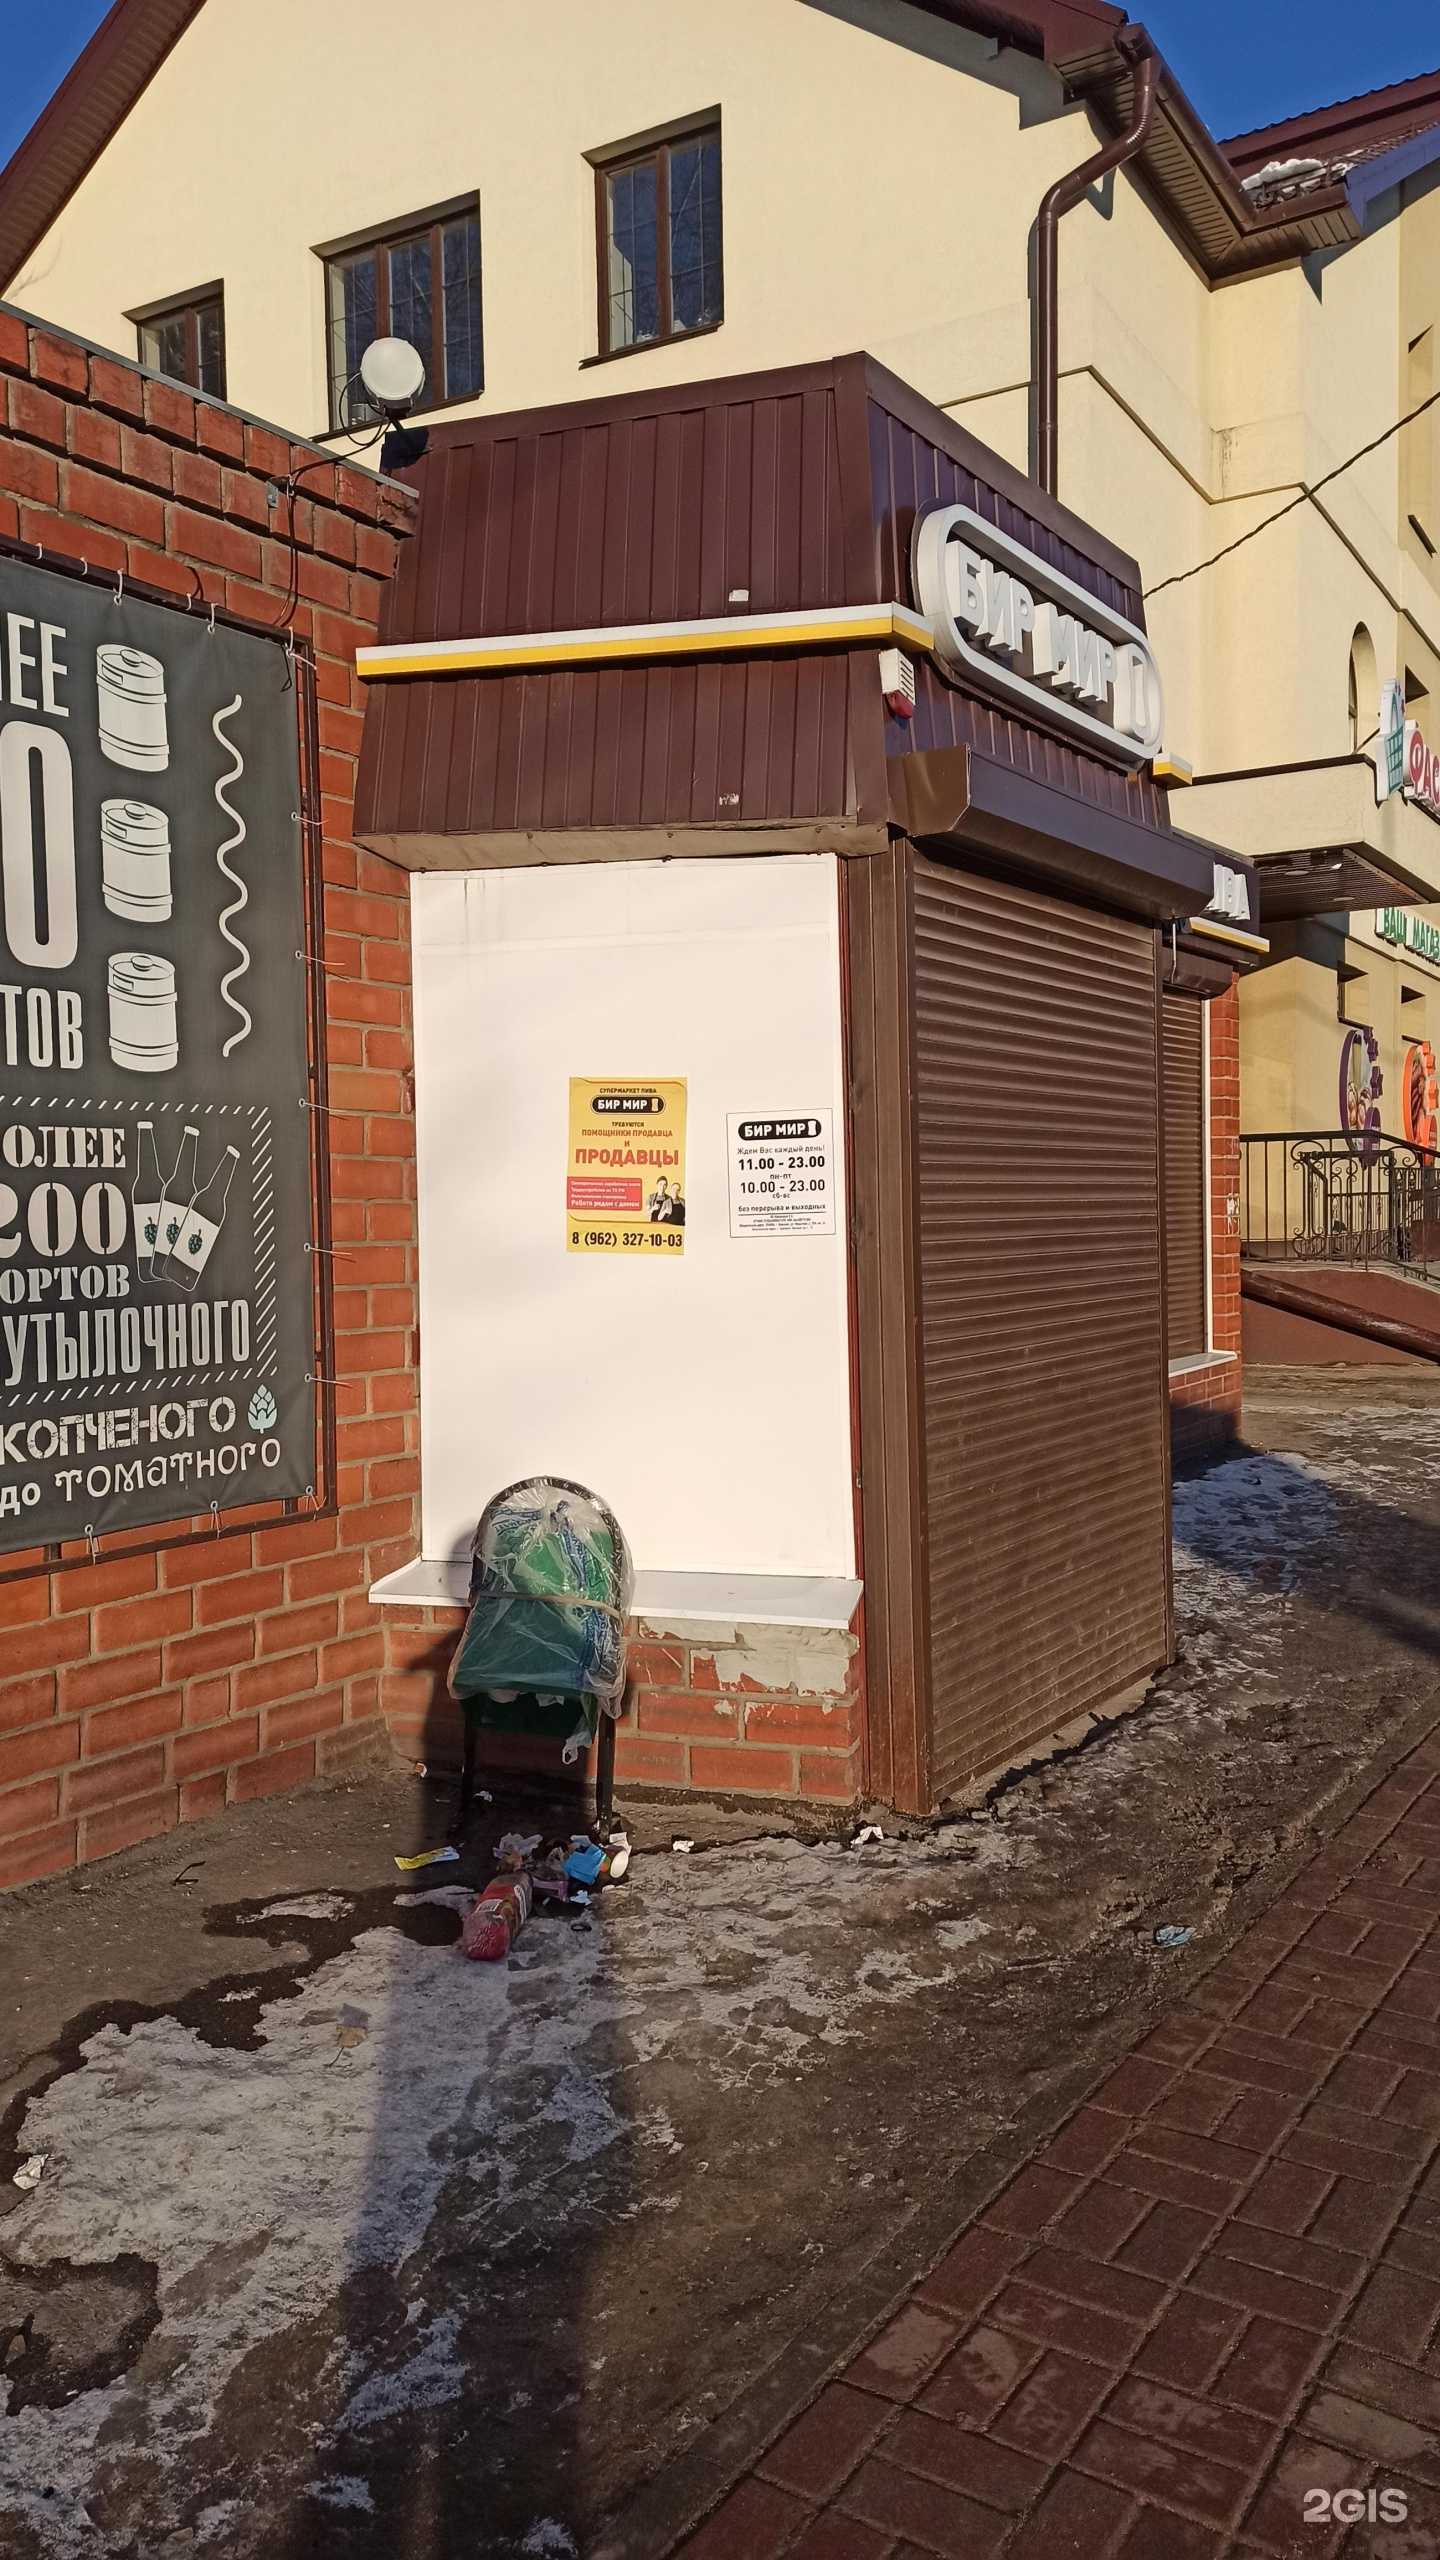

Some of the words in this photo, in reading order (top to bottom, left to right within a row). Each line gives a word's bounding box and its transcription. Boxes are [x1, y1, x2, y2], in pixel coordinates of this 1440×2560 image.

[946, 540, 1035, 654] БИР
[1033, 602, 1117, 703] МИР
[0, 612, 69, 717] ЕЕ
[597, 1099, 620, 1110] БИР
[622, 1099, 648, 1110] МИР
[581, 1129, 632, 1137] ПОМОЩНИКИ
[632, 1129, 673, 1138] ПРОДАВЦА
[744, 1124, 772, 1137] БИР
[775, 1123, 806, 1136] МИР
[2, 1124, 126, 1169] ОЛЕЕ
[774, 1145, 803, 1154] каждый
[575, 1148, 679, 1168] ПРОДАВЦЫ
[738, 1157, 775, 1170] 11.00
[788, 1155, 825, 1168] 23.00
[740, 1181, 776, 1193] 10.00
[789, 1179, 825, 1192] 23.00
[572, 1231, 579, 1245] 8
[584, 1232, 618, 1247] (962)
[622, 1232, 683, 1247] 327-10-03
[2, 1299, 250, 1387] УТЫЛОЧНОГО
